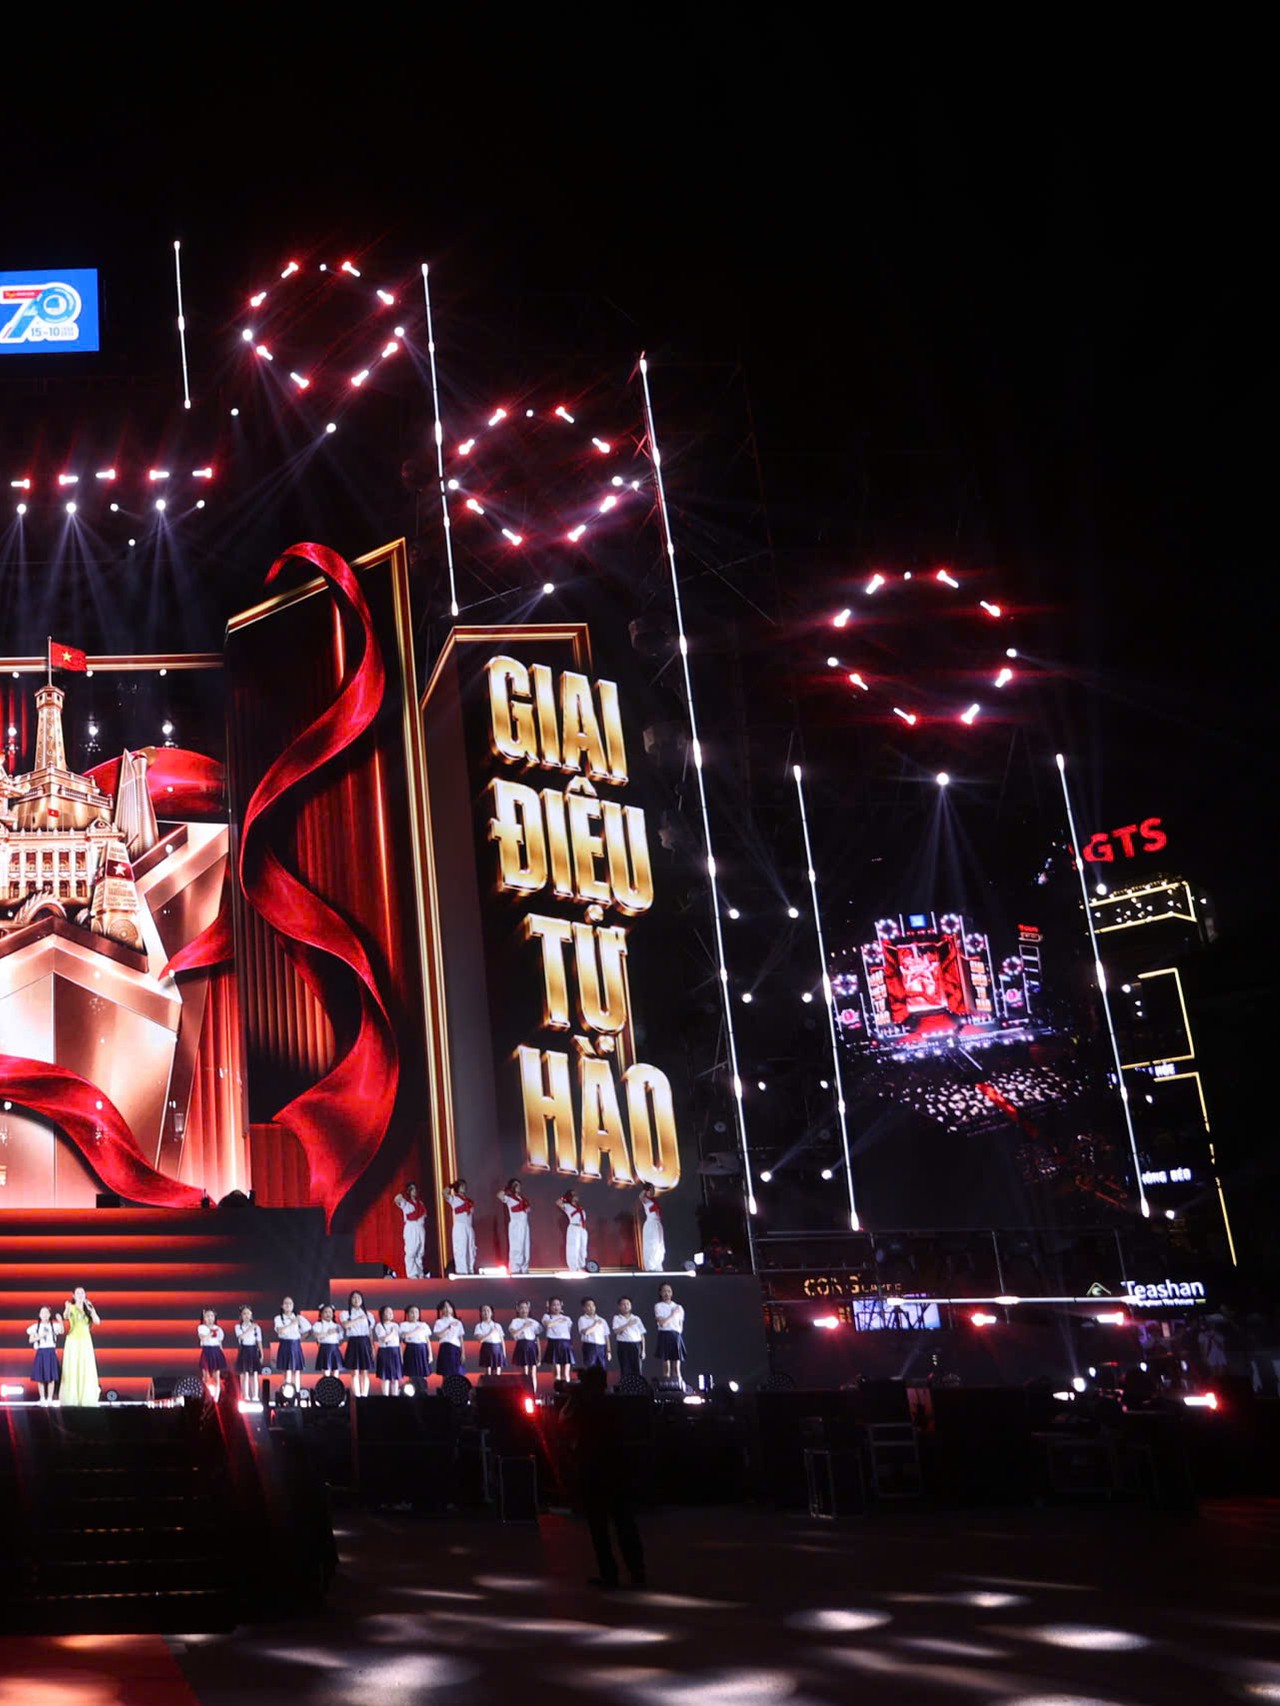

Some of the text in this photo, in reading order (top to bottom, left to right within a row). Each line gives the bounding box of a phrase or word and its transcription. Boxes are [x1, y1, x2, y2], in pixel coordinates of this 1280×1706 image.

[486, 655, 629, 786] GIAI
[489, 777, 654, 922] ĐIỆU
[524, 912, 628, 1054] TỰ
[516, 1035, 681, 1191] HÀO
[1120, 1278, 1205, 1299] Teashan
